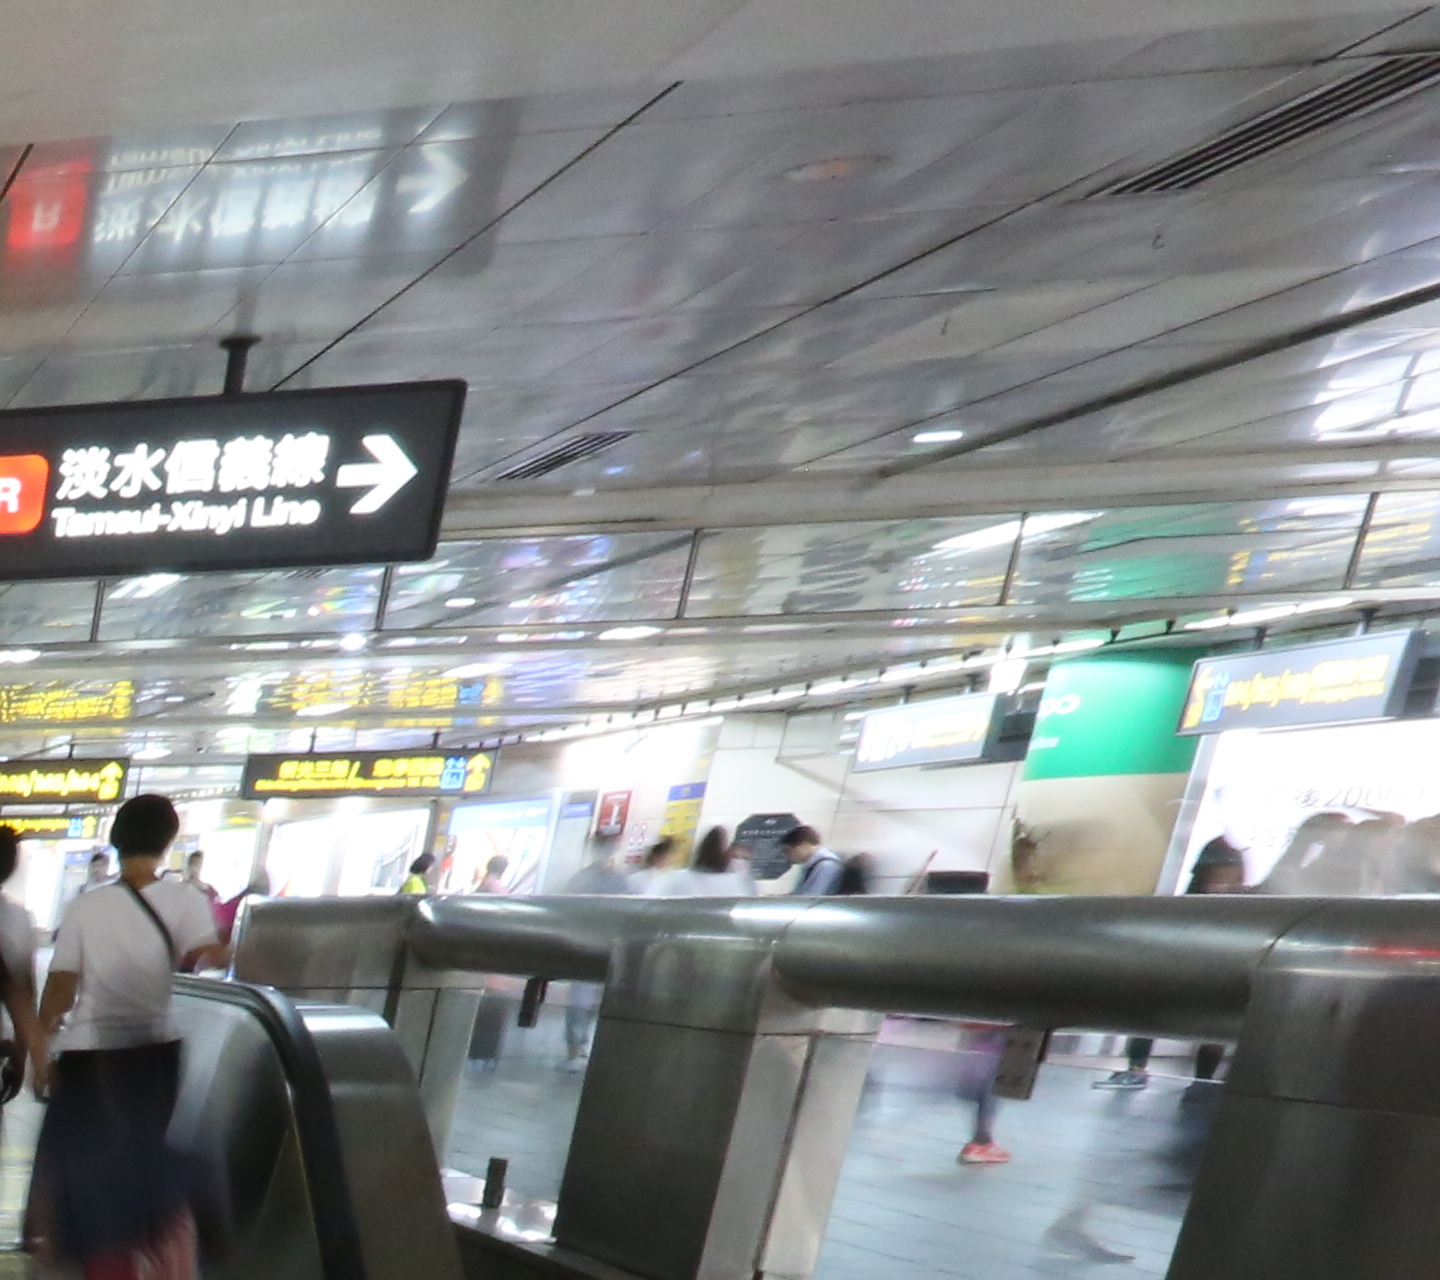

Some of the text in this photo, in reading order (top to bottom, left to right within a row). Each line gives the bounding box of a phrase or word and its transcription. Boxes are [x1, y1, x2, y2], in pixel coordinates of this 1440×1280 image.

[56, 432, 329, 499] 淡水信義線
[250, 495, 321, 528] Line
